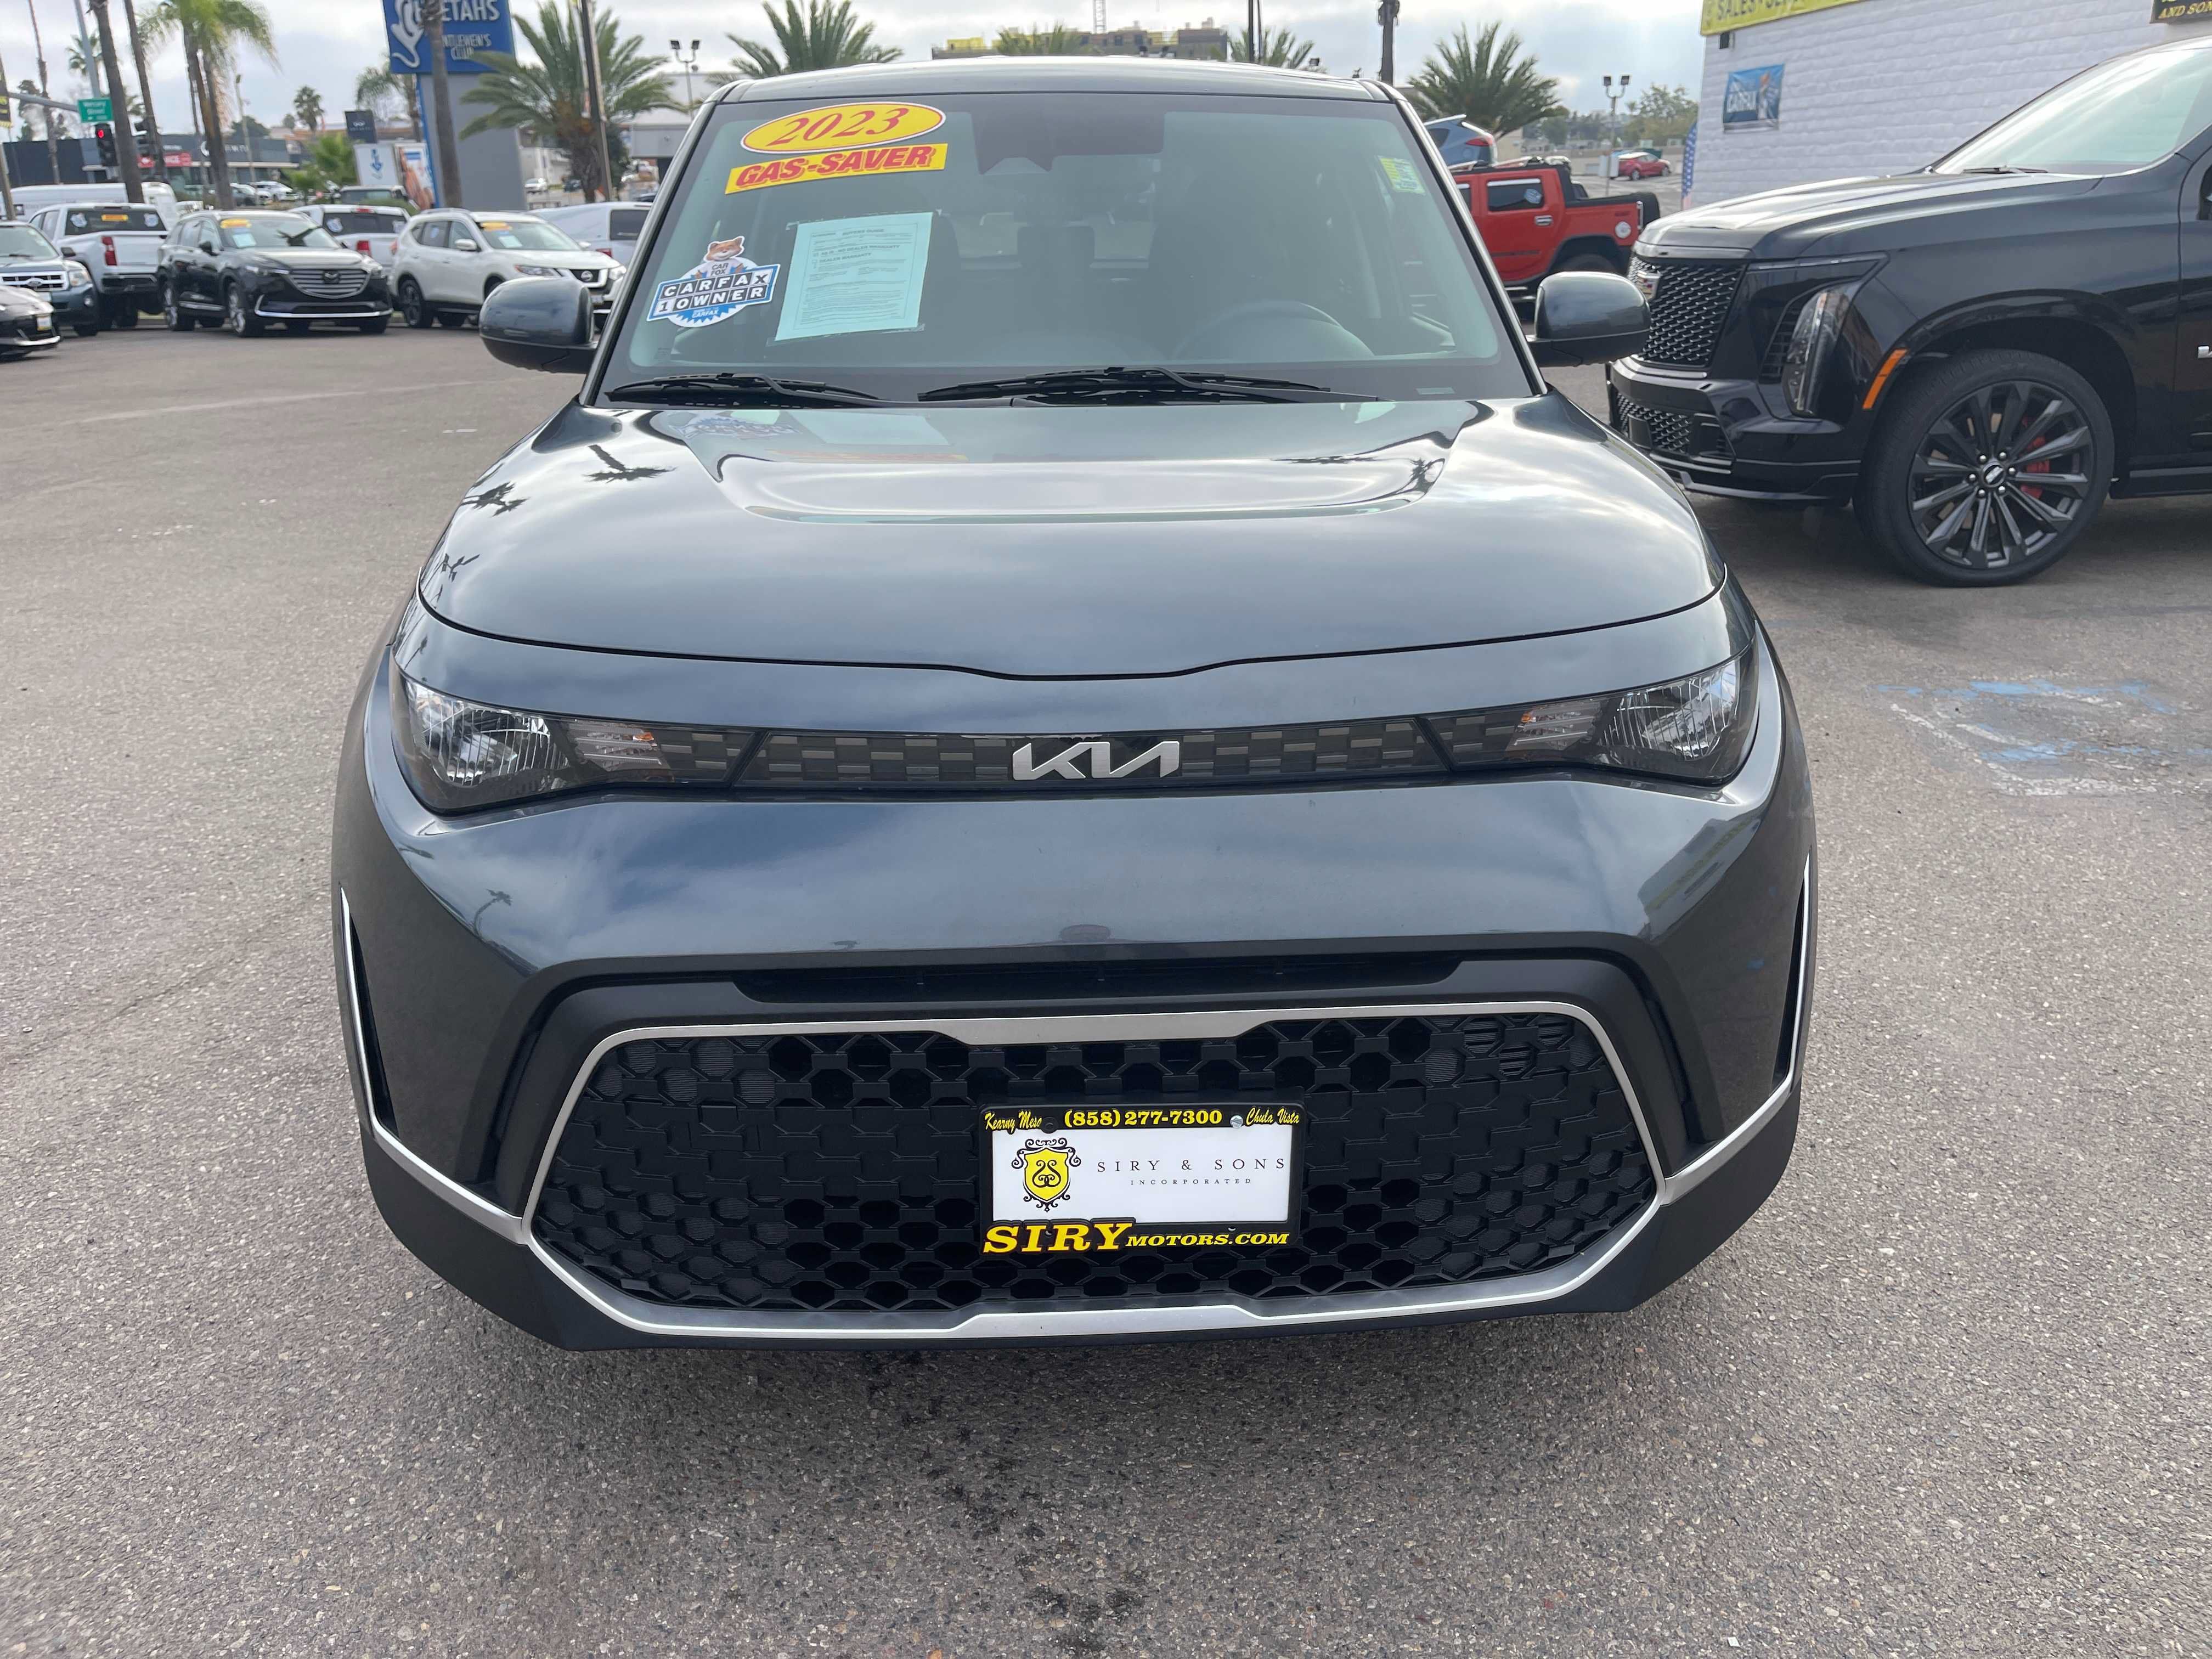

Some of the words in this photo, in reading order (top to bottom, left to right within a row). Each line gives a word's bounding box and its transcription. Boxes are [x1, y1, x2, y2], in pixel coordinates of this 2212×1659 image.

[2158, 5, 2186, 19] AND
[766, 108, 910, 147] 2023
[736, 145, 936, 189] GAS-SAVER
[664, 274, 768, 297] CARFAX
[659, 301, 669, 312] 1
[675, 286, 764, 309] OWNER
[984, 1111, 1015, 1133] Kearny
[1064, 1108, 1121, 1127] (858)
[1125, 1109, 1222, 1125] 277-7300
[1245, 1107, 1274, 1126] Chula
[1277, 1107, 1300, 1125] Vista
[1097, 1160, 1160, 1173] SIRY
[1181, 1159, 1193, 1171] &
[1214, 1158, 1285, 1170] SONS
[1130, 1178, 1252, 1186] INCORPORATED
